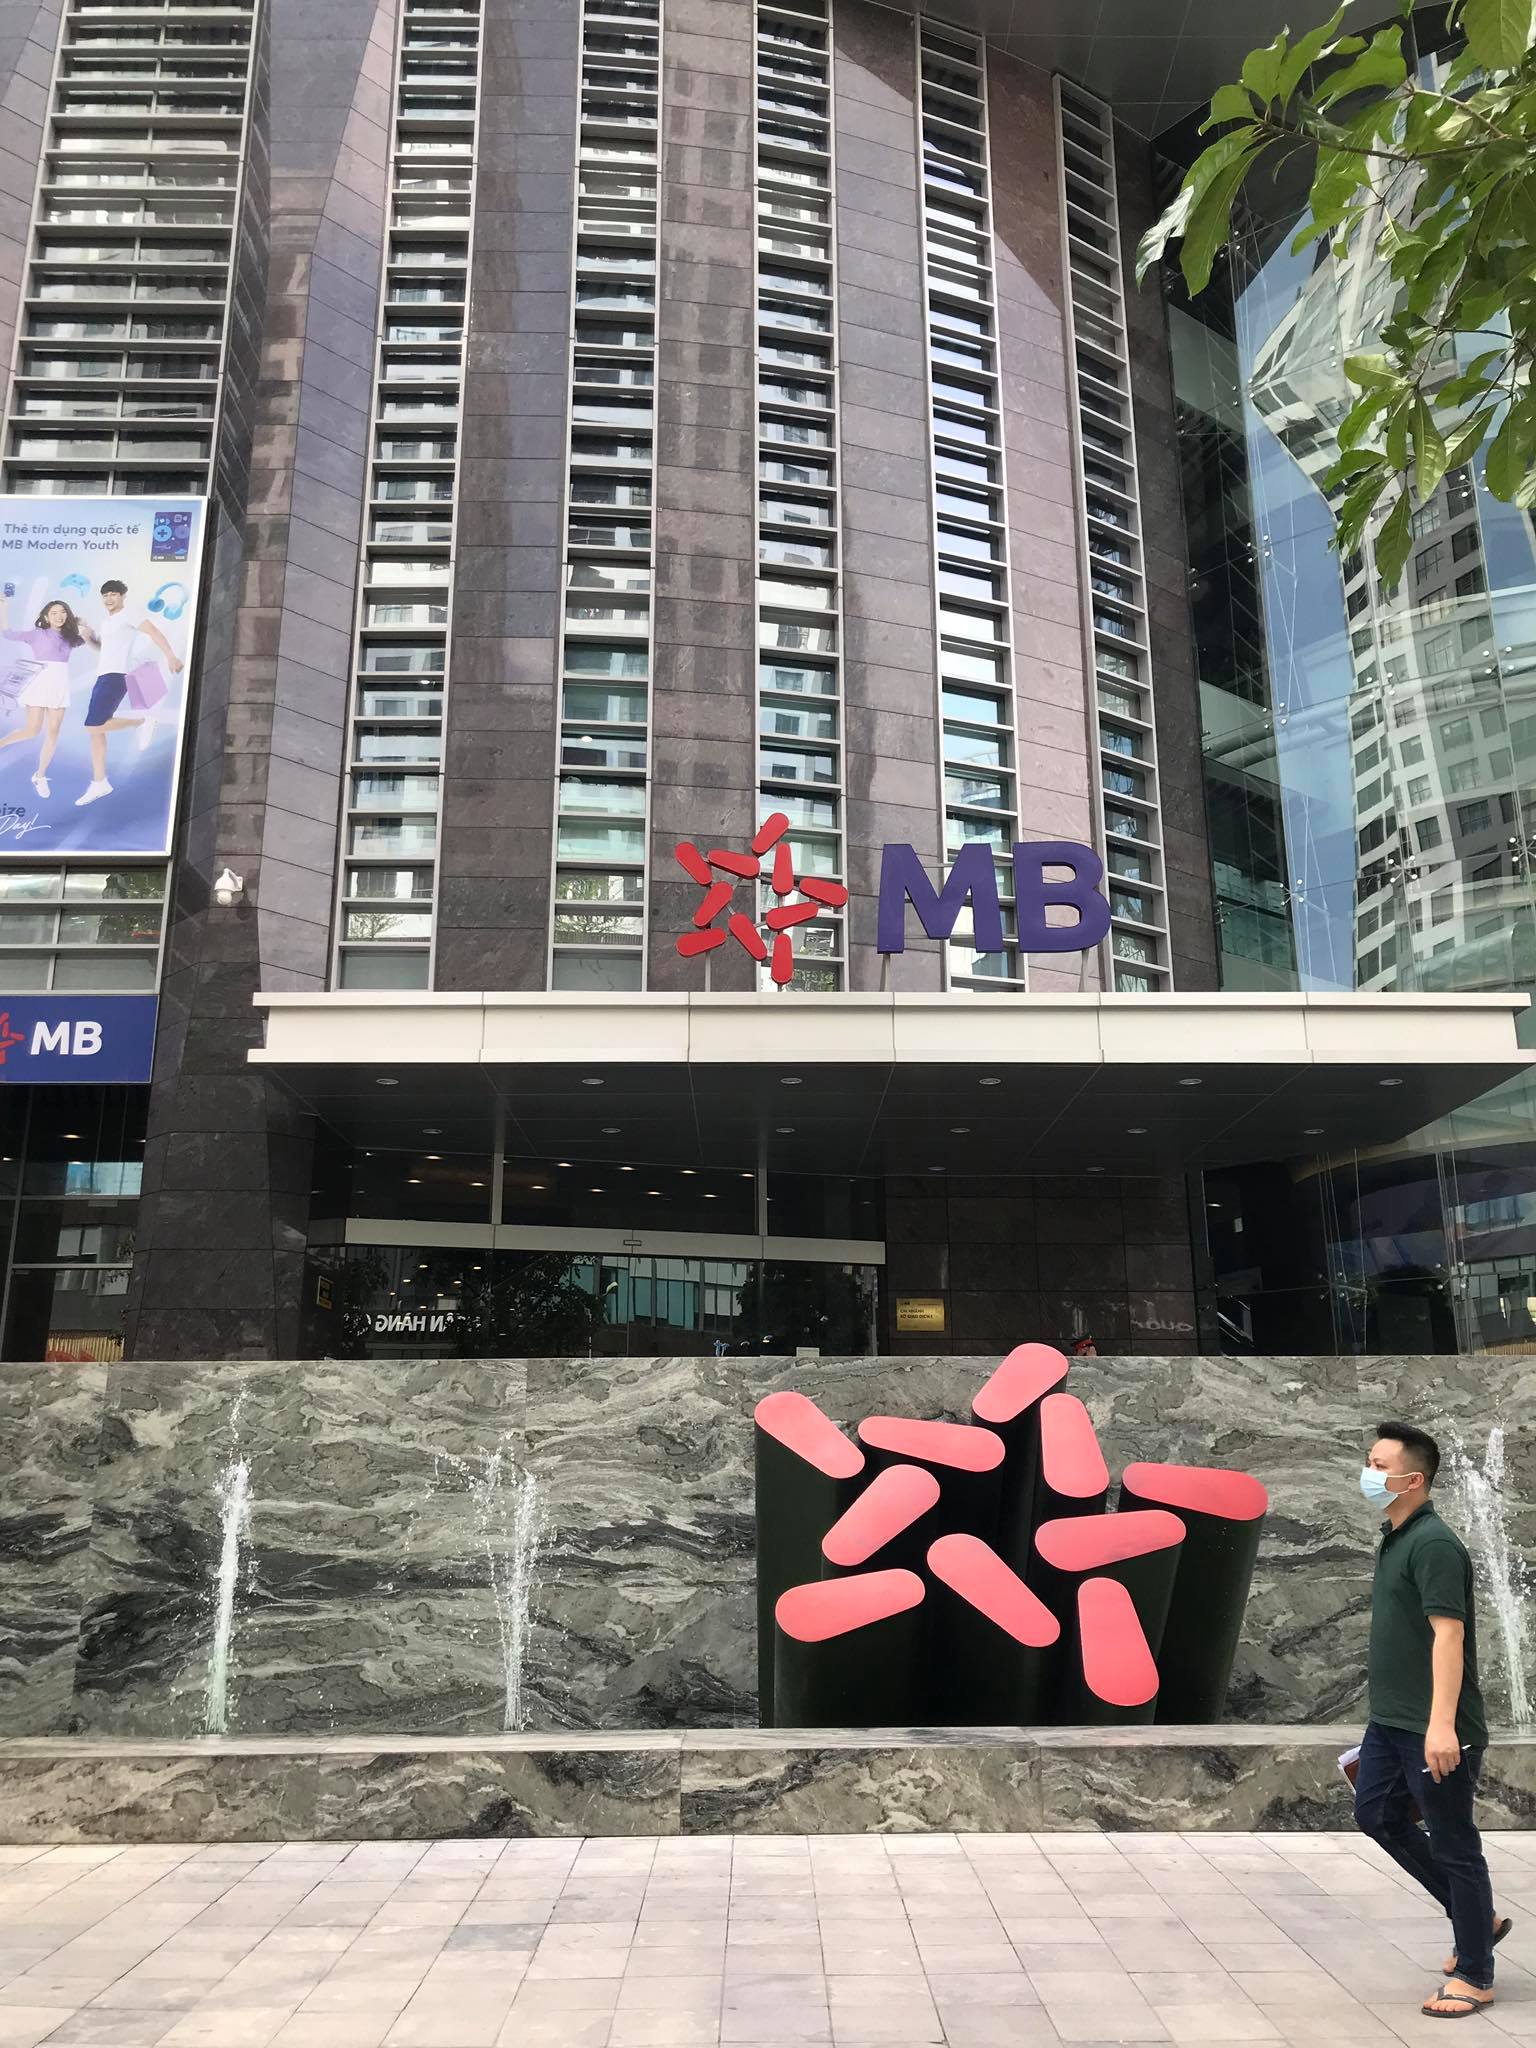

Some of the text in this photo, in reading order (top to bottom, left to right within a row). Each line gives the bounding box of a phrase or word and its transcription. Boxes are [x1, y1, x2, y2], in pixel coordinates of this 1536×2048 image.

[4, 522, 141, 537] Thẻ tín dụng quốc tế
[2, 540, 119, 550] MB Modern Youth
[0, 803, 26, 817] ize
[876, 840, 1112, 954] MB
[30, 1020, 104, 1056] MB
